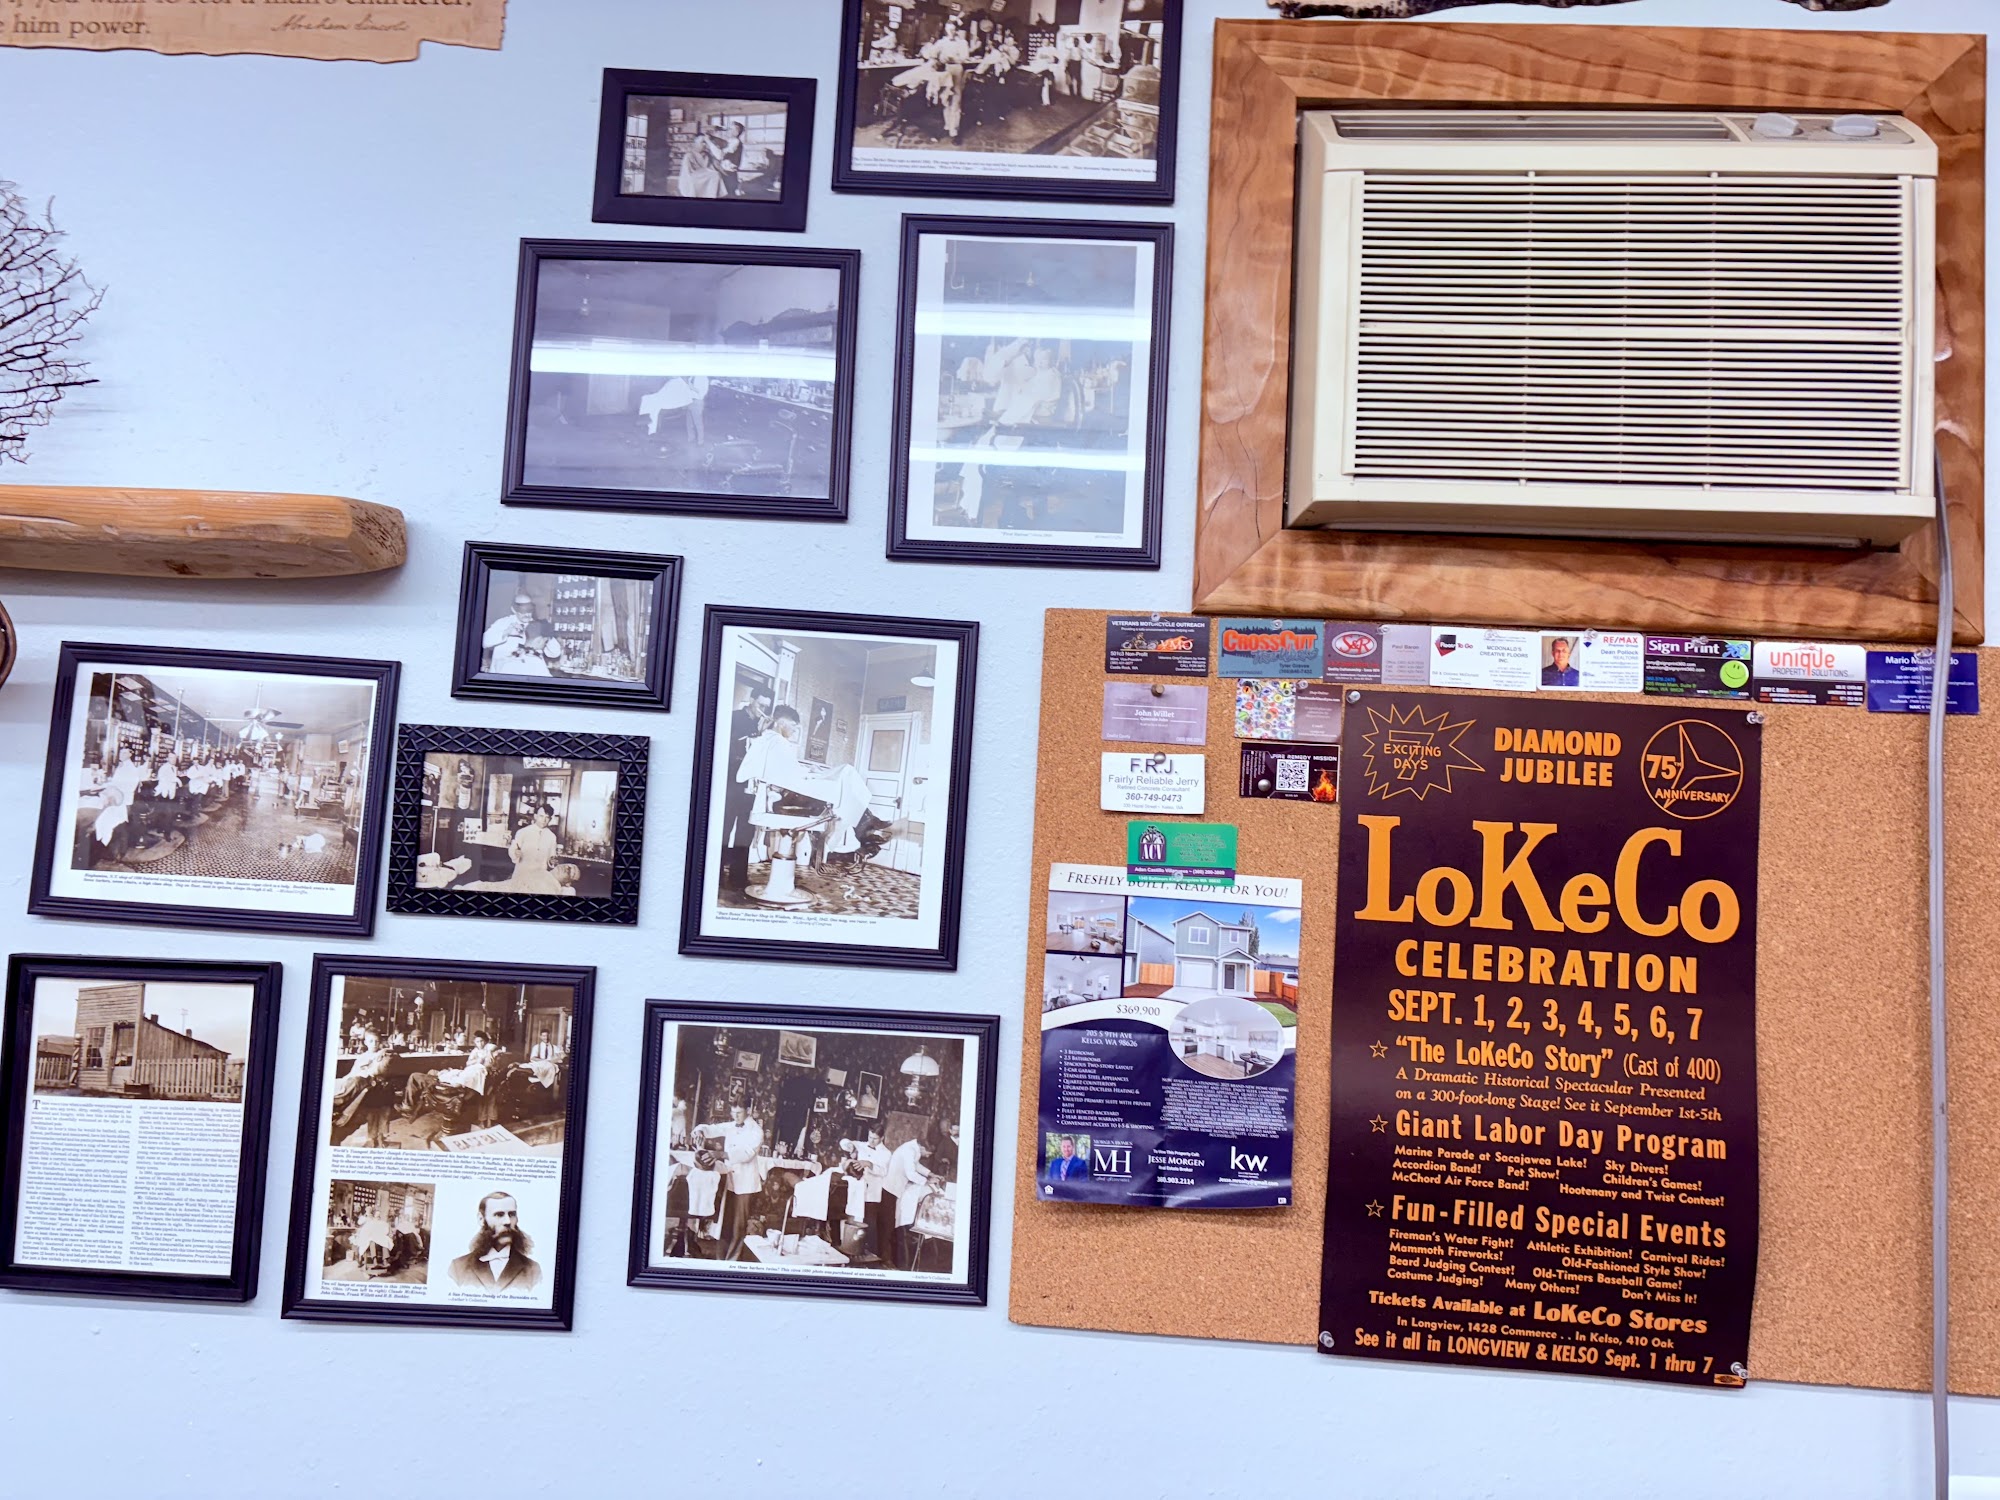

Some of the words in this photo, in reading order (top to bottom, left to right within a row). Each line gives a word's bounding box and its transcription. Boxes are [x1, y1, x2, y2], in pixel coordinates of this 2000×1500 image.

[12, 15, 61, 34] him
[69, 19, 151, 39] power.
[1140, 620, 1175, 628] MOTORCYCLE
[1603, 636, 1639, 644] RE/MAX
[1648, 639, 1680, 655] Sign
[1684, 641, 1720, 654] Print
[1770, 647, 1835, 676] unique
[1772, 667, 1806, 676] PROPERTY
[1811, 668, 1849, 678] SOLUTIONS
[1134, 709, 1152, 717] John
[1153, 710, 1175, 718] Willet
[1384, 743, 1441, 759] EXCITING
[1494, 727, 1621, 756] DIAMOND
[1130, 757, 1178, 774] F.R.J.
[1393, 757, 1429, 770] DAYS
[1500, 757, 1612, 786] JUBILEE
[1108, 774, 1134, 785] Fairly
[1136, 775, 1174, 785] Reliable
[1176, 776, 1200, 788] Jerry
[1125, 792, 1183, 803] 360-749-0473
[1654, 788, 1731, 803] ANNIVERSARY
[1141, 843, 1164, 860] ACV
[1067, 871, 1125, 886] FRESHLY
[1222, 884, 1249, 895] FOR
[1254, 884, 1289, 899] YOU!
[1354, 814, 1740, 943] LoKeCo
[1395, 939, 1698, 993] CELEBRATION
[1388, 989, 1462, 1024] SEPT.
[1474, 994, 1494, 1032] 1,
[1506, 996, 1530, 1035] 2,
[1542, 999, 1566, 1037] 3,
[1578, 1001, 1602, 1039] 4,
[1614, 1003, 1638, 1041] 5,
[1650, 1005, 1674, 1044] 6,
[1687, 1008, 1702, 1040] 7
[1085, 1029, 1098, 1037] 705
[1104, 1030, 1118, 1038] 9TH
[1120, 1031, 1133, 1039] AVE
[1105, 1038, 1118, 1046] WA
[1119, 1039, 1138, 1047] 98626
[1396, 1035, 1444, 1063] "The
[1456, 1039, 1533, 1069] LoKeCo
[1545, 1044, 1613, 1078] Story"
[1623, 1053, 1658, 1077] (Cast
[1665, 1056, 1678, 1077] of
[1687, 1057, 1720, 1084] 400)
[1395, 1067, 1408, 1079] A
[1414, 1067, 1478, 1084] Dramatic
[1484, 1072, 1549, 1088] Historical
[1555, 1077, 1633, 1094] Spectacular
[1640, 1083, 1705, 1100] Presented
[1395, 1090, 1412, 1099] on
[1416, 1091, 1426, 1100] a
[1430, 1089, 1516, 1109] 300-foot-long
[1520, 1094, 1560, 1111] Stage!
[1564, 1097, 1586, 1111] See
[1590, 1099, 1600, 1112] it
[1604, 1100, 1673, 1117] September
[1679, 1107, 1721, 1121] 1st-5th
[1396, 1109, 1461, 1139] Giant
[1475, 1114, 1545, 1145] Labor
[1559, 1120, 1603, 1154] Day
[1617, 1125, 1726, 1160] Program
[1094, 1149, 1132, 1173] MH
[1147, 1155, 1167, 1165] JESSE
[1168, 1156, 1205, 1167] MORGEN
[1393, 1158, 1446, 1171] Accordion
[1450, 1162, 1481, 1173] Band!
[1394, 1145, 1432, 1157] Marine
[1438, 1147, 1474, 1160] Parade
[1479, 1152, 1490, 1160] at
[1495, 1151, 1551, 1165] Sacajawea
[1557, 1156, 1586, 1168] Lake!
[1507, 1166, 1524, 1177] Pet
[1528, 1167, 1559, 1179] Show!
[1605, 1159, 1625, 1173] Sky
[1630, 1161, 1668, 1174] Divers!
[1392, 1171, 1441, 1184] McChord
[1444, 1175, 1462, 1185] Air
[1465, 1176, 1494, 1188] Force
[1498, 1178, 1529, 1190] Band!
[1603, 1173, 1657, 1187] Children's
[1661, 1178, 1702, 1191] Games!
[1560, 1183, 1618, 1200] Hootenany
[1621, 1189, 1641, 1199] and
[1645, 1190, 1675, 1202] Twist
[1678, 1193, 1724, 1206] Contest!
[1535, 1206, 1628, 1239] Special
[1640, 1214, 1725, 1247] Events
[1389, 1228, 1440, 1241] Fireman's
[1444, 1232, 1478, 1244] Water
[1481, 1236, 1513, 1249] Fight!
[1389, 1242, 1444, 1255] Mammoth
[1448, 1246, 1503, 1260] Fireworks!
[1526, 1240, 1570, 1253] Athletic
[1574, 1244, 1632, 1259] Exhibition!
[1641, 1250, 1687, 1263] Carnival
[1691, 1254, 1724, 1266] Rides!
[1390, 1255, 1419, 1267] Beard
[1423, 1257, 1466, 1273] Judging
[1469, 1261, 1514, 1275] Contest!
[1562, 1256, 1640, 1273] Old-Fashioned
[1643, 1263, 1670, 1277] Style
[1674, 1266, 1706, 1278] Show!
[1387, 1268, 1433, 1281] Costume
[1436, 1272, 1483, 1287] Judging!
[1505, 1278, 1536, 1292] Many
[1540, 1281, 1579, 1294] Others!
[1533, 1267, 1593, 1282] Old-Timers
[1597, 1273, 1642, 1286] Baseball
[1646, 1277, 1682, 1289] Game!
[1622, 1288, 1652, 1300] Don't
[1655, 1291, 1680, 1302] Miss
[1684, 1293, 1697, 1303] It!
[1369, 1290, 1426, 1308] Tickets
[1432, 1296, 1503, 1314] Available
[1509, 1305, 1525, 1316] at
[1534, 1301, 1621, 1326] LoKeCo
[1629, 1309, 1707, 1333] Stores
[1397, 1316, 1407, 1326] In
[1411, 1317, 1463, 1332] Longview,
[1468, 1322, 1496, 1333] 1428
[1500, 1325, 1557, 1338] Commerce
[1575, 1331, 1586, 1341] In
[1590, 1332, 1622, 1345] Kelso,
[1626, 1335, 1648, 1346] 410
[1651, 1337, 1674, 1348] Oak
[1355, 1327, 1379, 1347] See
[1386, 1330, 1396, 1348] it
[1403, 1331, 1420, 1350] all
[1427, 1334, 1440, 1351] in
[1448, 1335, 1530, 1358] LONGVIEW
[1535, 1343, 1547, 1360] &
[1552, 1344, 1598, 1364] KELSO
[1605, 1348, 1640, 1371] Sept.
[1650, 1352, 1656, 1369] 1
[1665, 1353, 1695, 1372] thru
[1703, 1356, 1714, 1374] 7
